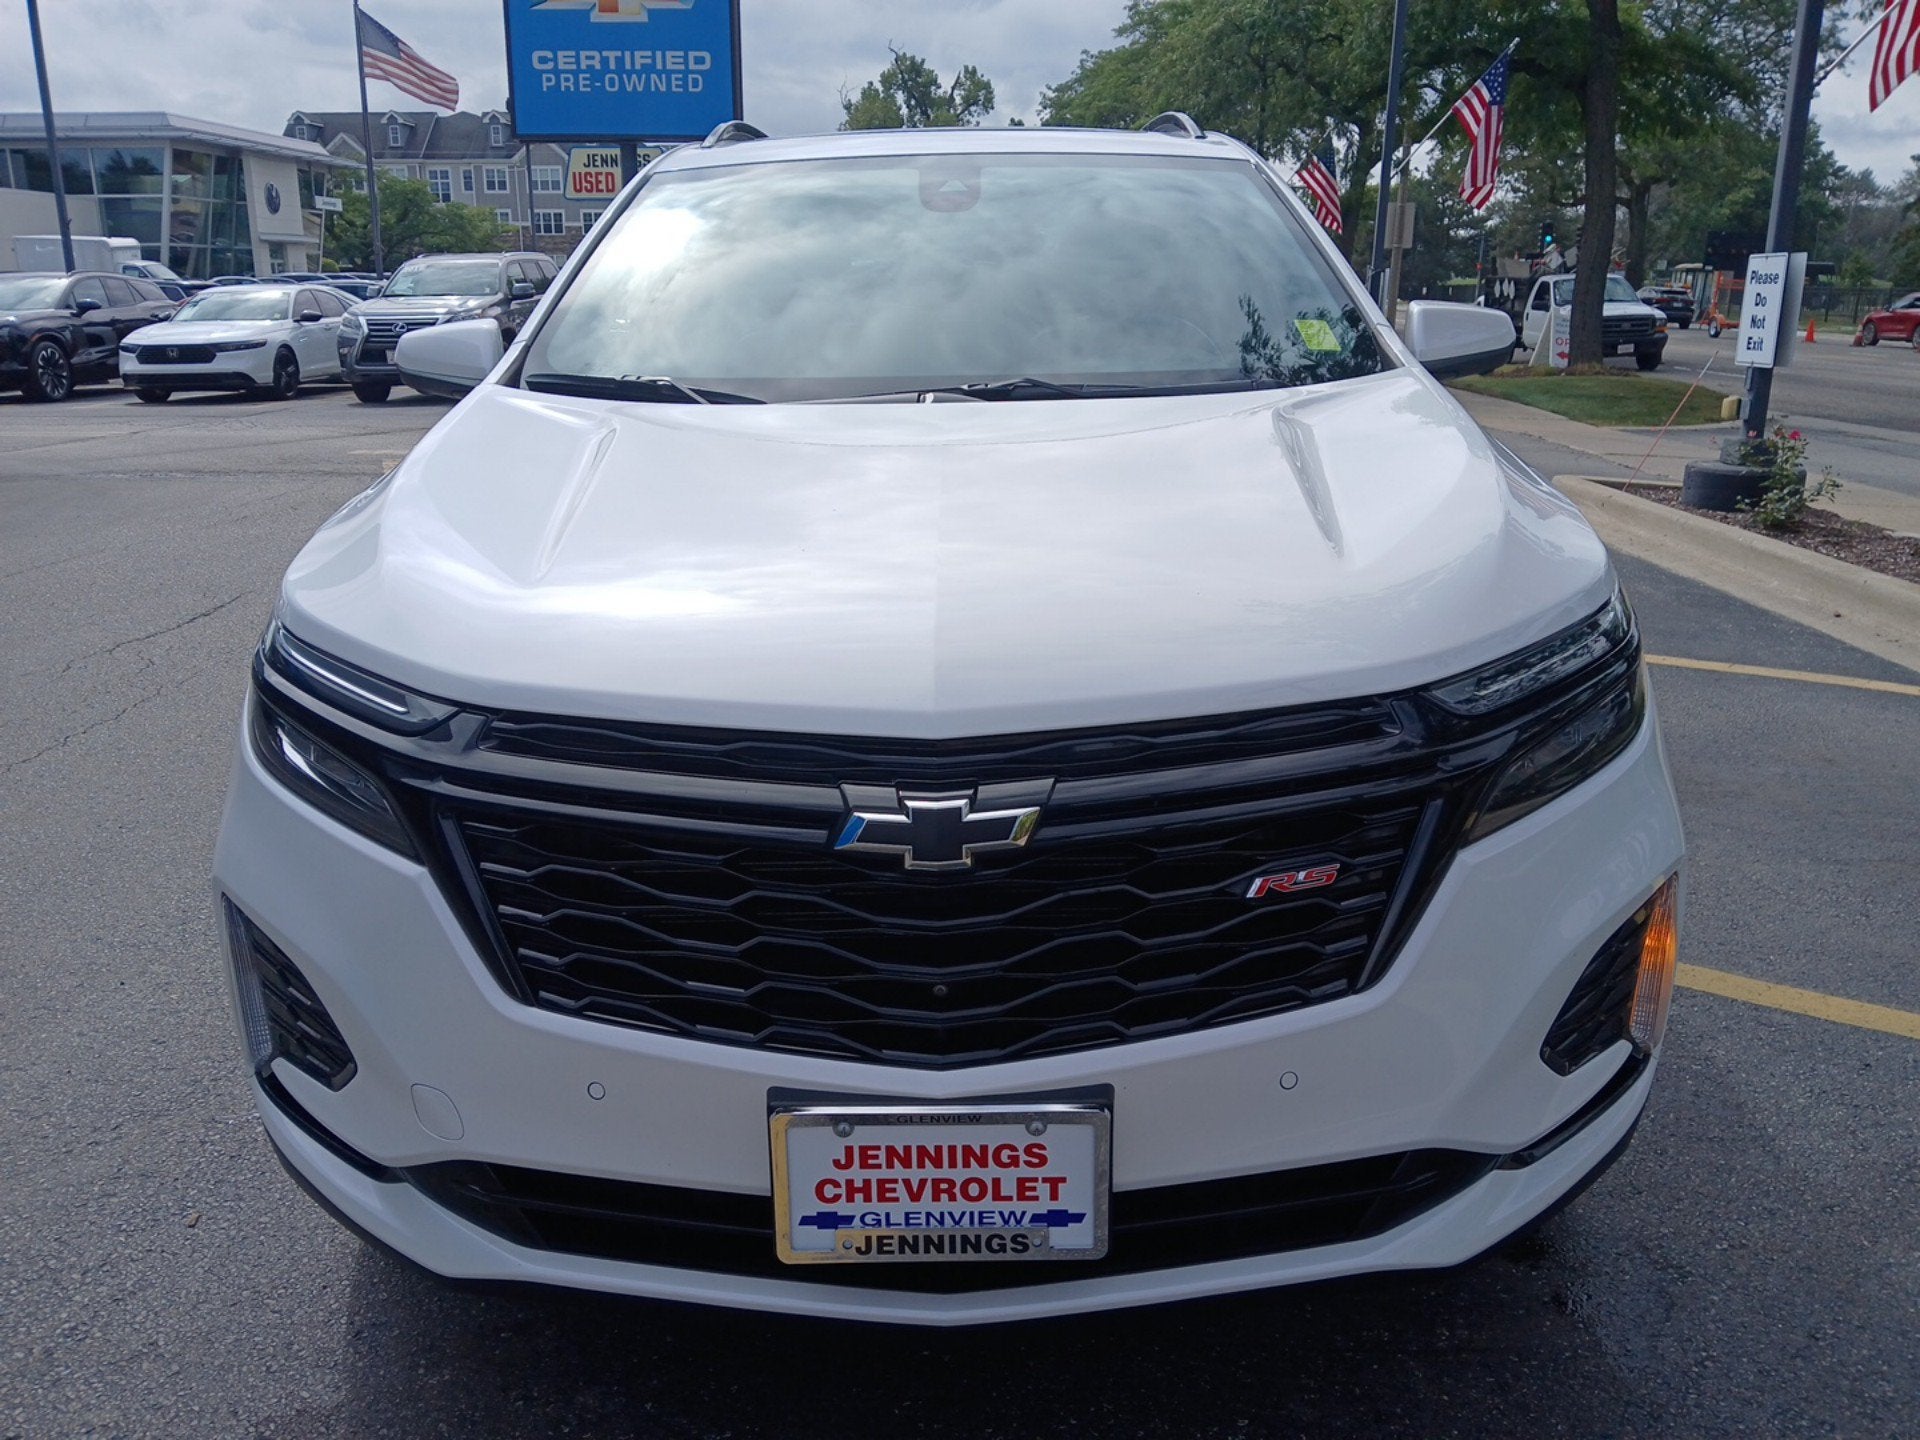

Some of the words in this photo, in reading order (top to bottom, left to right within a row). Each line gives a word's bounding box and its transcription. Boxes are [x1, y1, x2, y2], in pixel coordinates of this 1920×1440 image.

[531, 50, 712, 70] CERTIFIED
[541, 73, 704, 92] PRE-OWNED
[583, 153, 651, 168] JENNGS
[572, 171, 616, 193] USED
[1749, 270, 1780, 285] Please
[1754, 292, 1767, 307] Do
[1750, 314, 1766, 329] Not
[1746, 336, 1764, 351] Exit
[1246, 863, 1340, 898] RS
[896, 1115, 983, 1124] GLENVIEW
[832, 1143, 1049, 1171] JENNINGS
[814, 1177, 1067, 1204] CHEVROLET
[859, 1210, 1028, 1228] GLENVIEW
[855, 1233, 1031, 1256] JENNINGS
